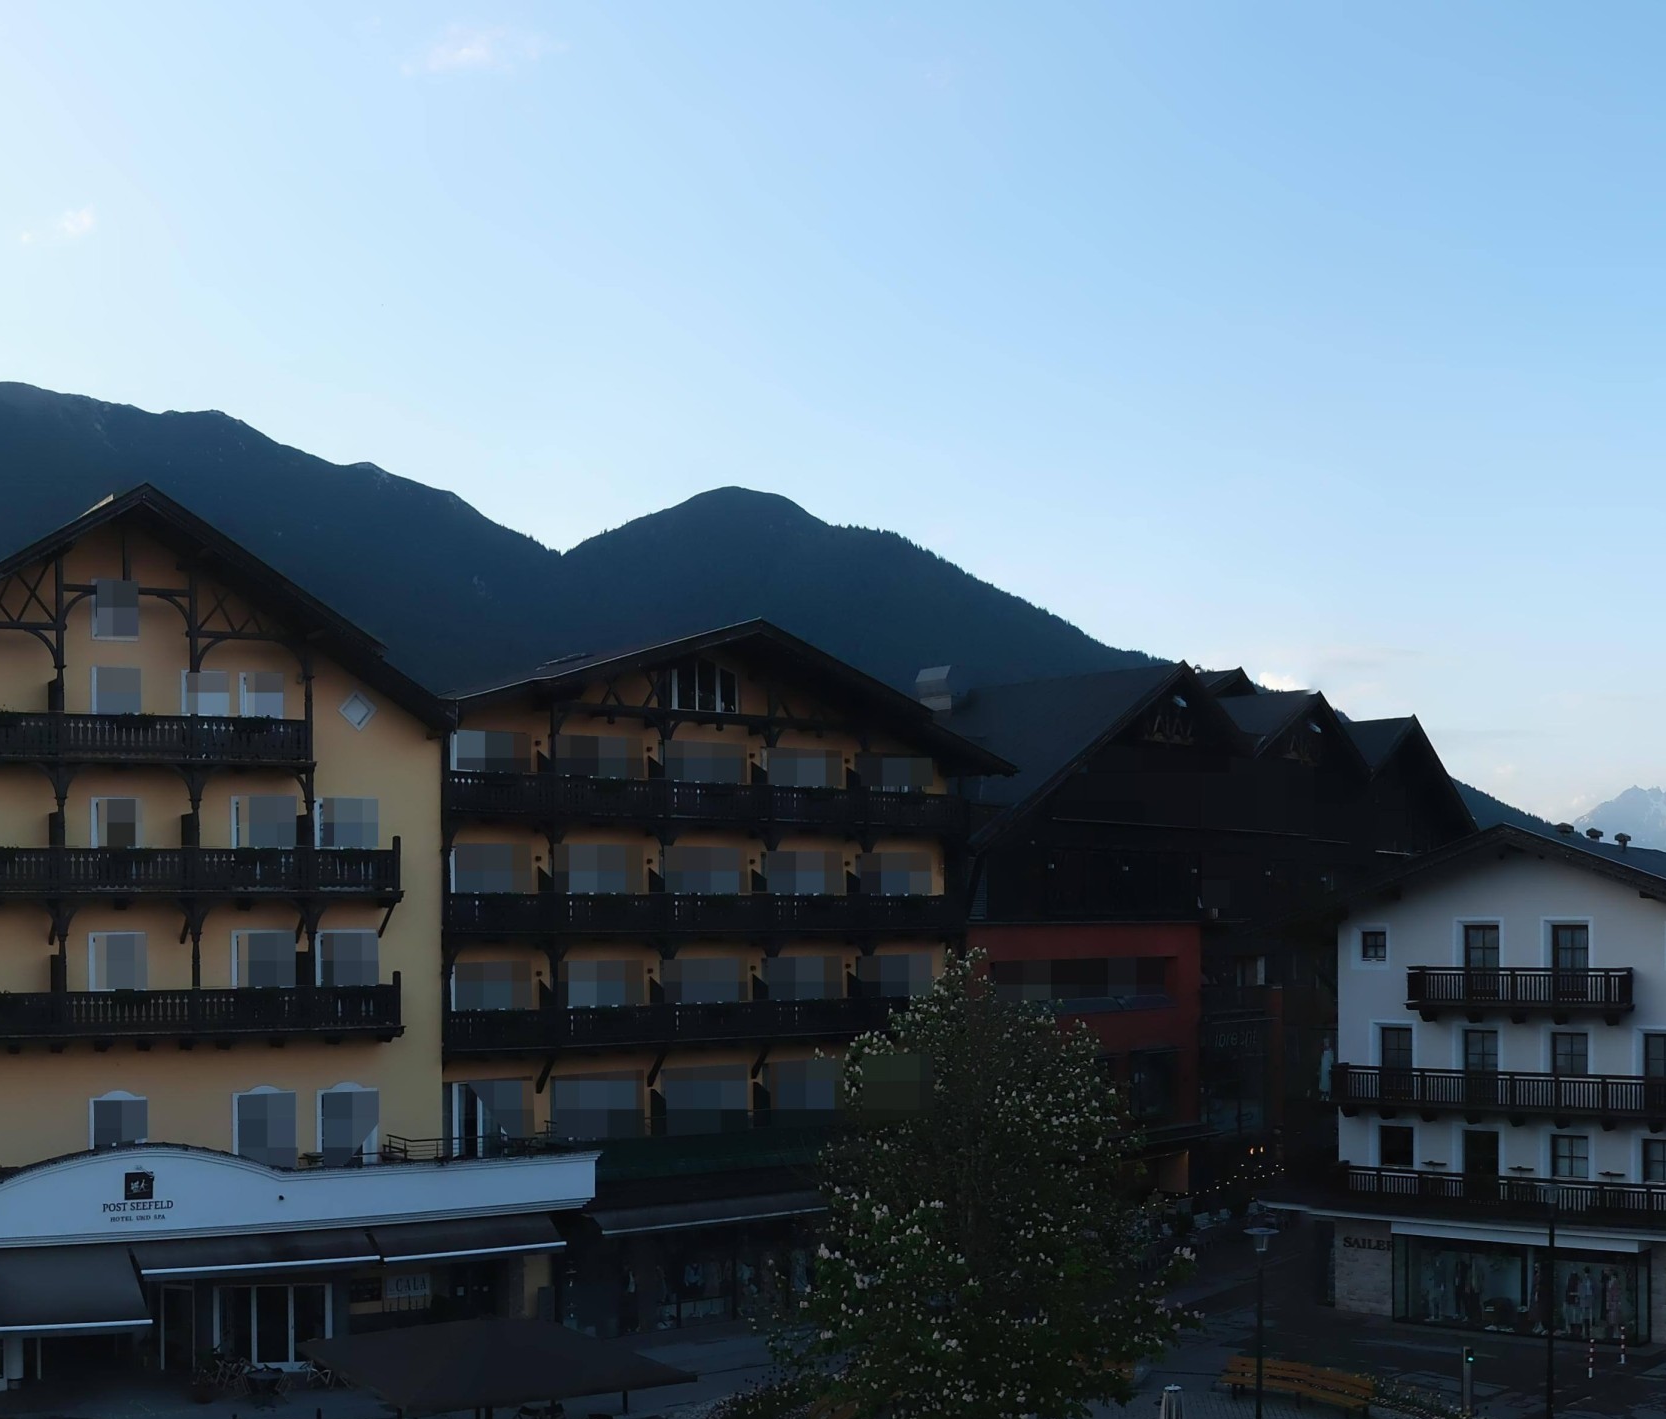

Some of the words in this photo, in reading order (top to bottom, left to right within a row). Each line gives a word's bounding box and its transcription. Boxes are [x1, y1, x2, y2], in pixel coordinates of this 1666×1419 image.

[102, 1202, 127, 1213] POST
[130, 1200, 174, 1211] SEEFELD
[396, 1276, 427, 1292] CALA
